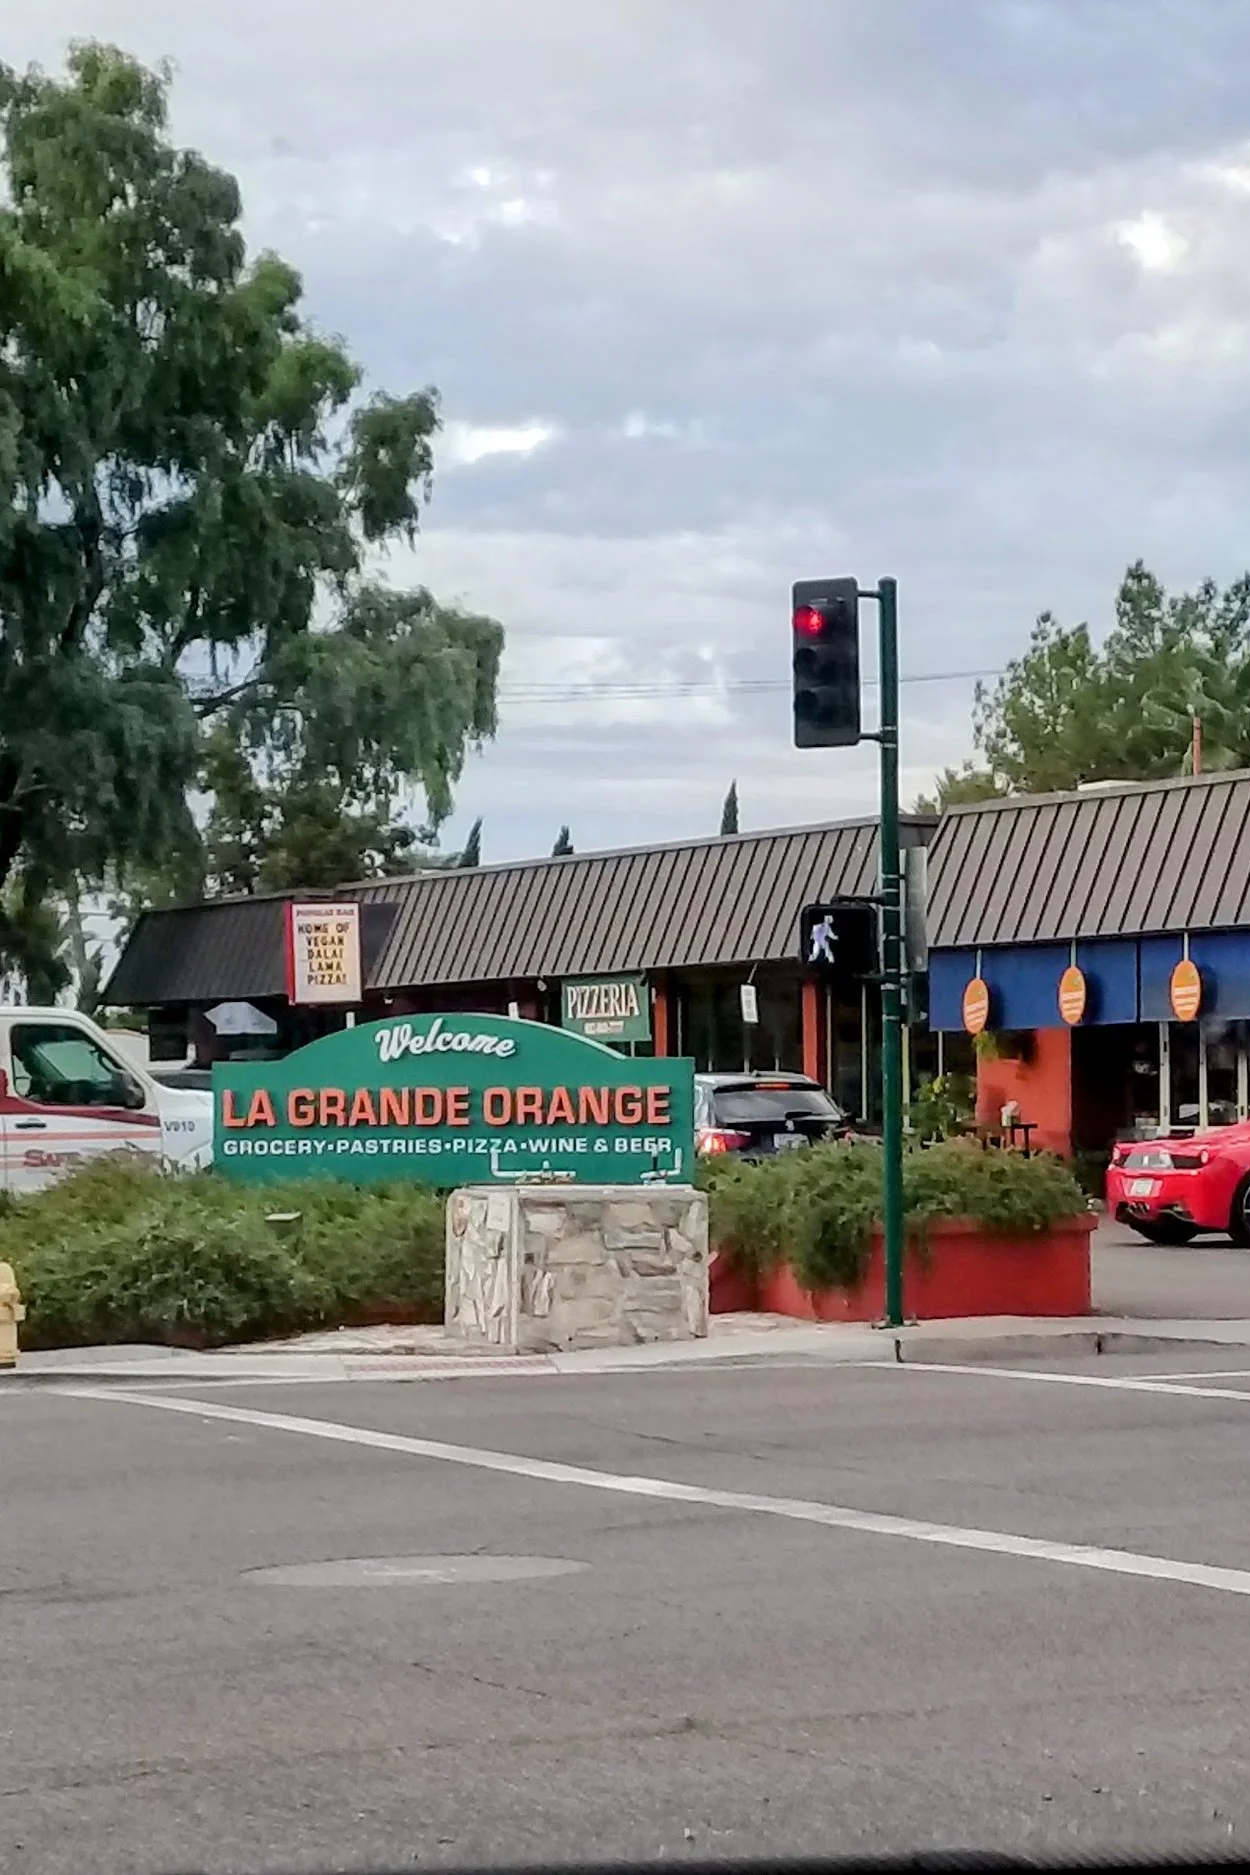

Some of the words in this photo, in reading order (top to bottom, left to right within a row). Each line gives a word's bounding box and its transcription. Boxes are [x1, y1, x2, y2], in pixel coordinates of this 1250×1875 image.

[297, 923, 329, 934] HOME
[335, 923, 350, 933] OF
[306, 936, 345, 947] VEGAN
[307, 948, 343, 959] DALAI
[309, 961, 343, 972] LAMA
[566, 983, 640, 1019] PIZZERIA
[375, 1017, 516, 1062] Welcome
[222, 1088, 277, 1127] LA
[287, 1086, 471, 1127] GRANDE
[483, 1084, 672, 1126] ORANGE
[223, 1138, 327, 1156] GROCERY
[337, 1138, 442, 1155] PASTRIES
[453, 1137, 519, 1154] PIZZA
[527, 1137, 588, 1154] WINE
[593, 1137, 609, 1154] &
[615, 1136, 672, 1154] BEER
